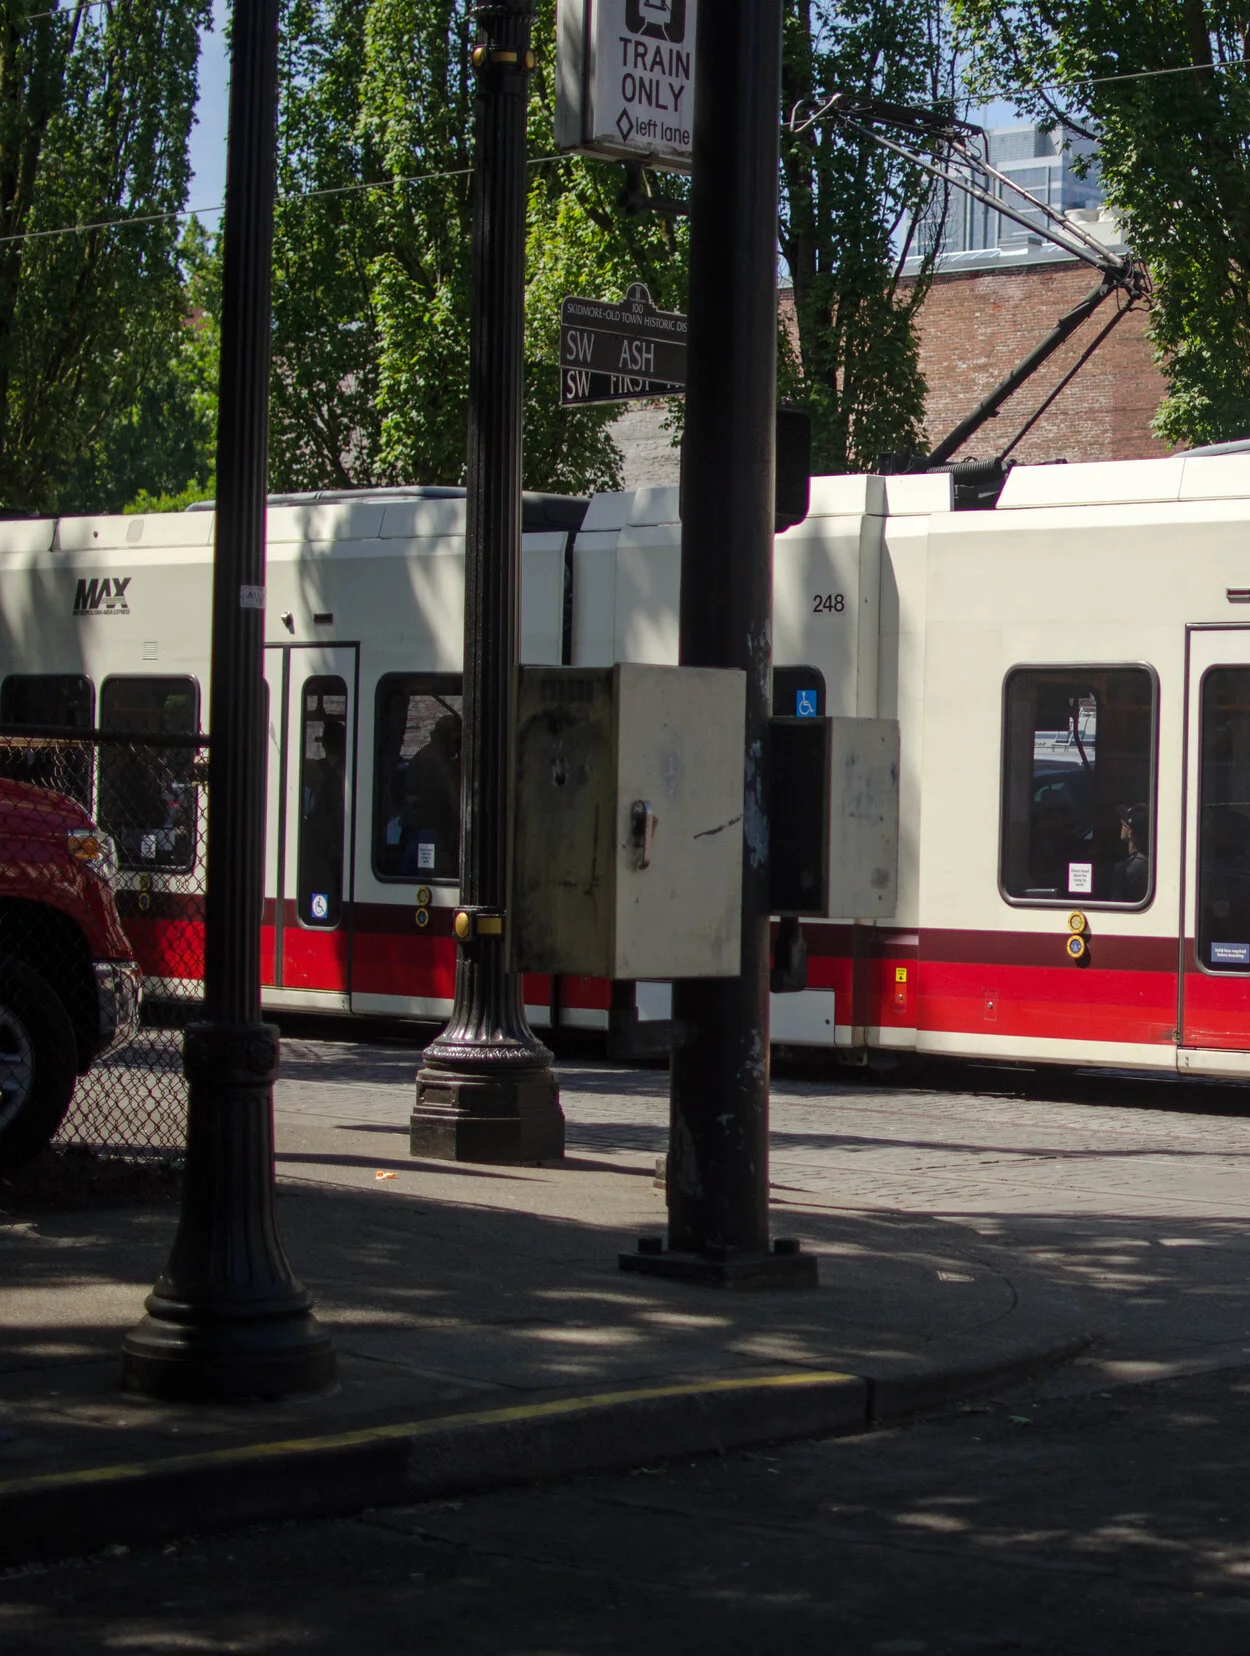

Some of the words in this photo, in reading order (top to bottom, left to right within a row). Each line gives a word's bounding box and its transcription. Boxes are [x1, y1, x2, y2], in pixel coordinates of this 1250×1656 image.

[619, 36, 690, 81] TRAIN
[622, 73, 685, 112] ONLY
[635, 116, 658, 139] left
[660, 121, 690, 145] lane
[621, 312, 643, 325] TOWN
[644, 316, 675, 331] HISTORIC
[676, 321, 688, 333] DIS
[632, 303, 644, 313] 100
[566, 330, 595, 363] SW
[618, 339, 655, 373] ASH
[566, 370, 592, 399] SW
[73, 577, 132, 610] MAX
[813, 594, 845, 613] 248
